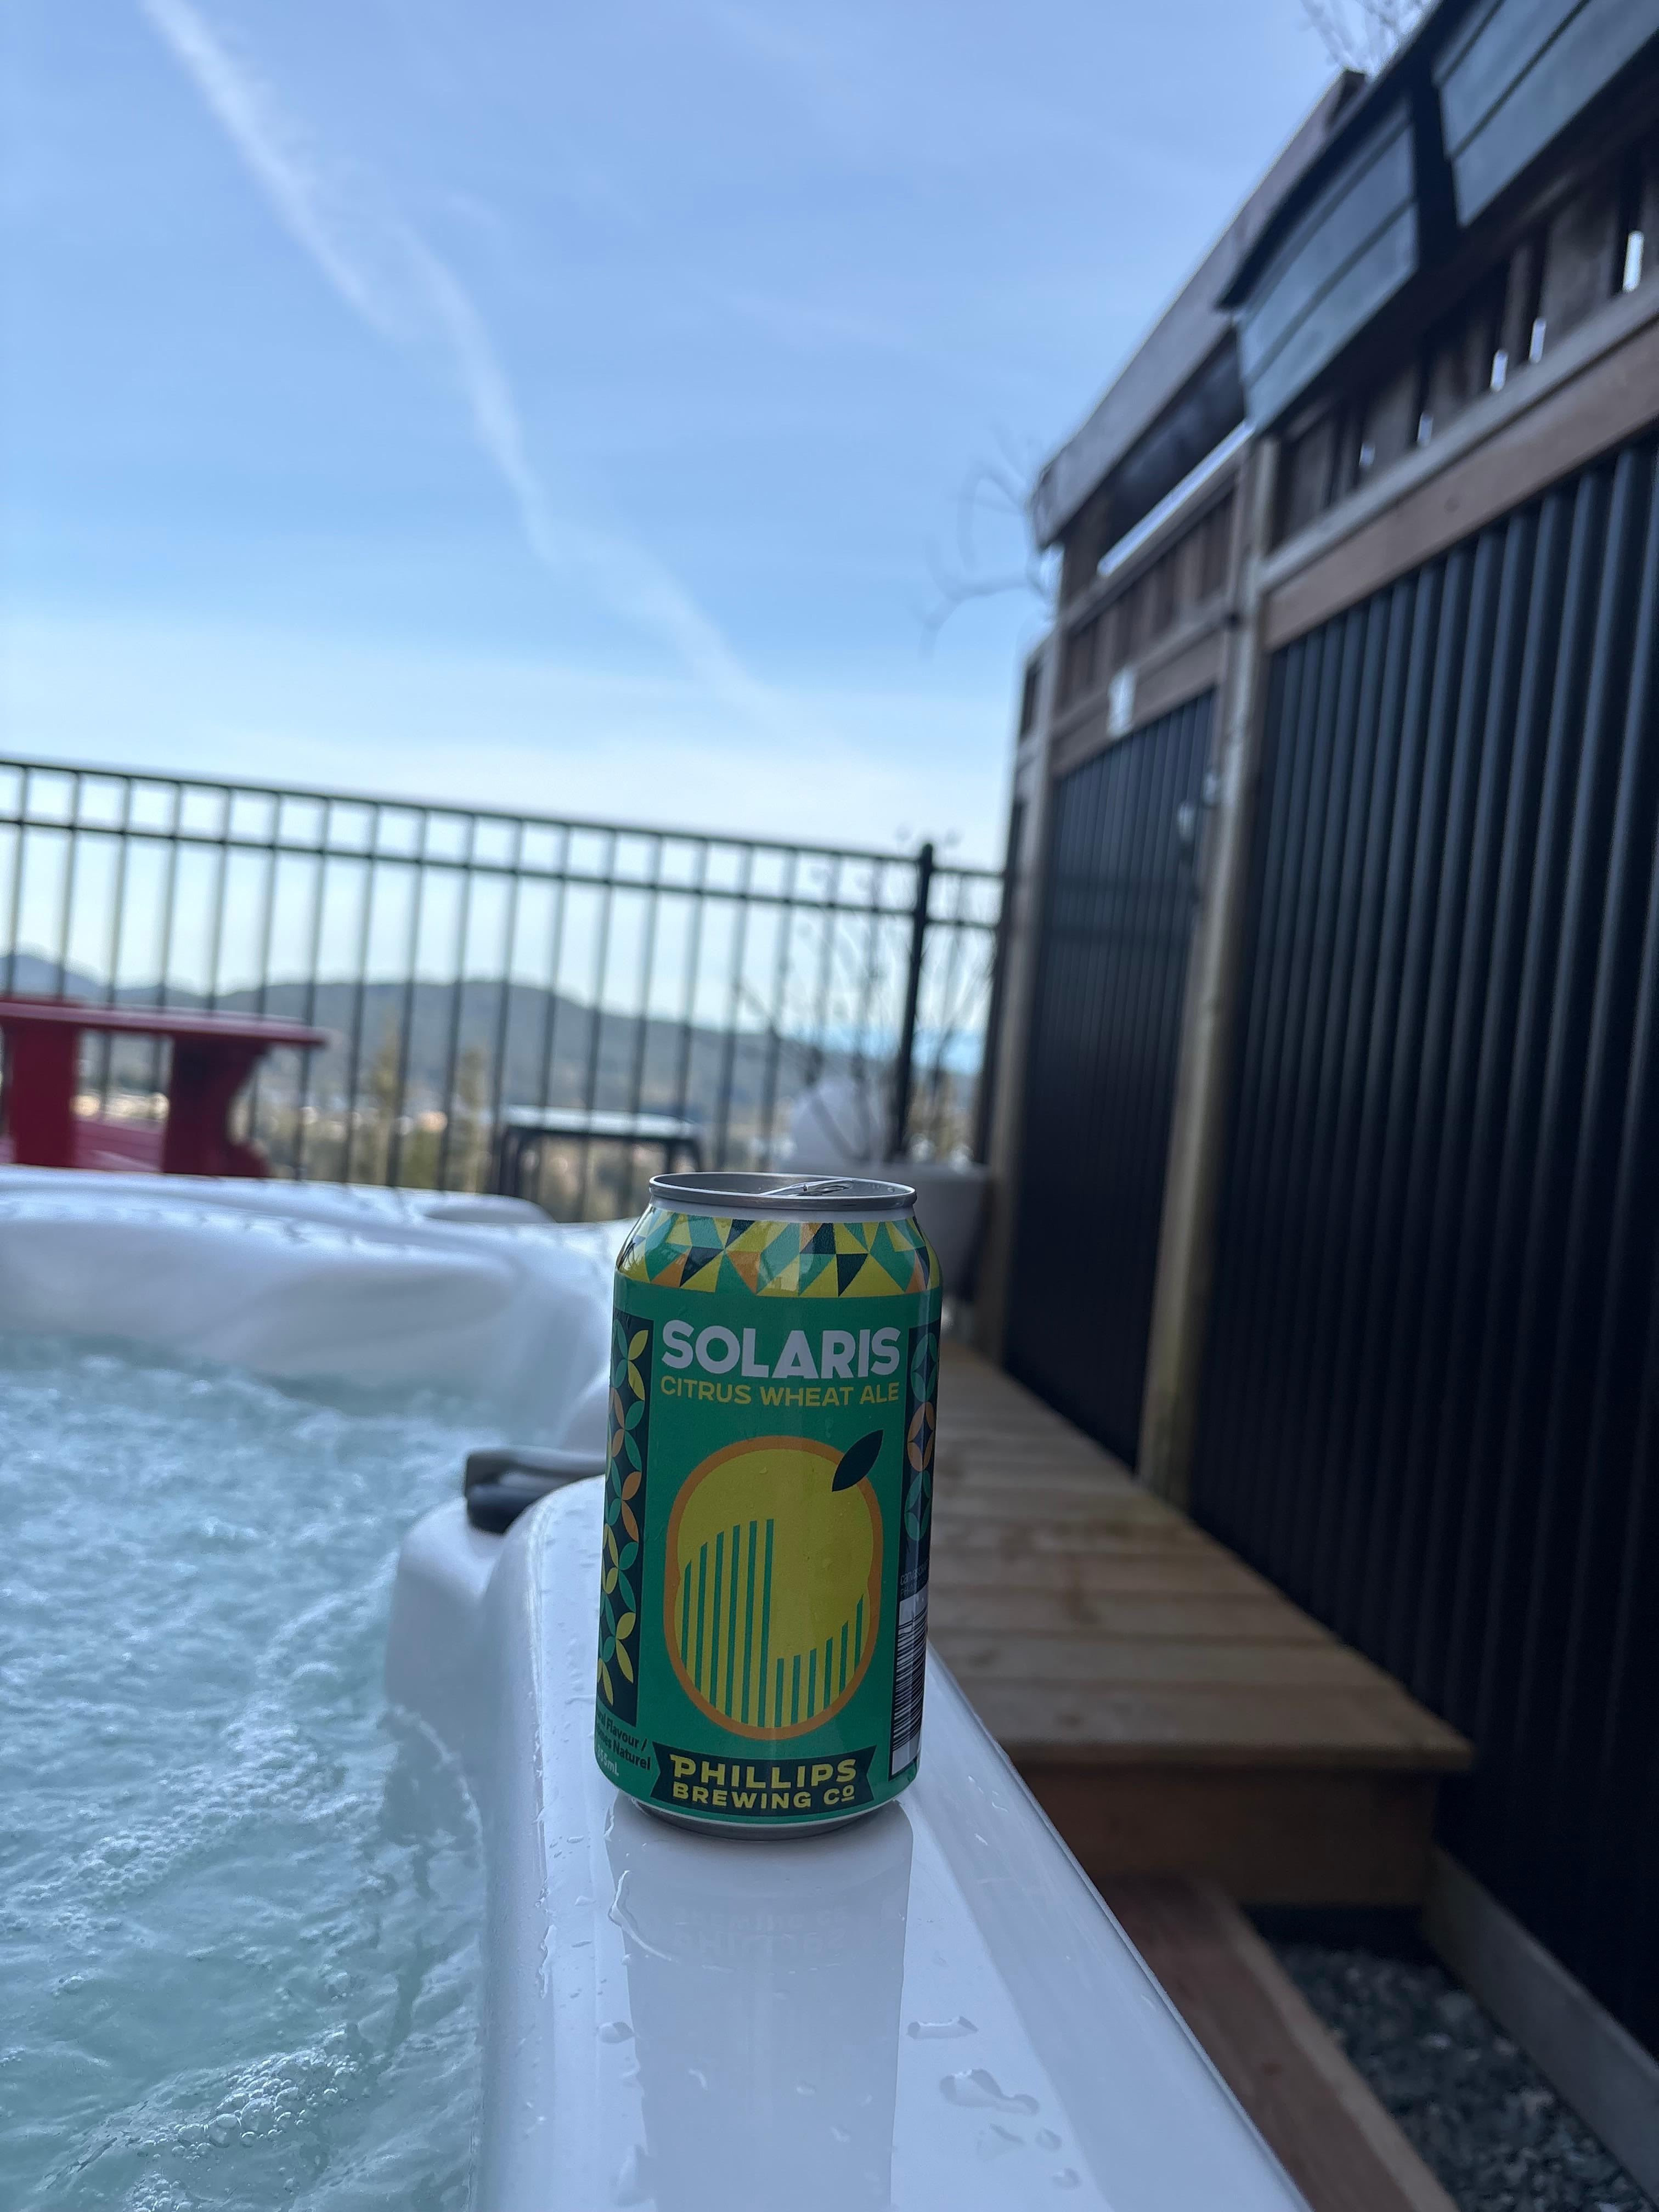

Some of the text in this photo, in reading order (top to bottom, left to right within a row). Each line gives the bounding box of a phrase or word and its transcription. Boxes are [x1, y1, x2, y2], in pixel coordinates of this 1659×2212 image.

[662, 1319, 901, 1379] SOLARIS
[661, 1375, 900, 1407] CITRUS WHEAT ALE
[606, 1717, 640, 1748] Flavour
[613, 1739, 651, 1770] Naturel
[669, 1754, 856, 1789] PHILLIPS
[673, 1781, 811, 1809] BREWING
